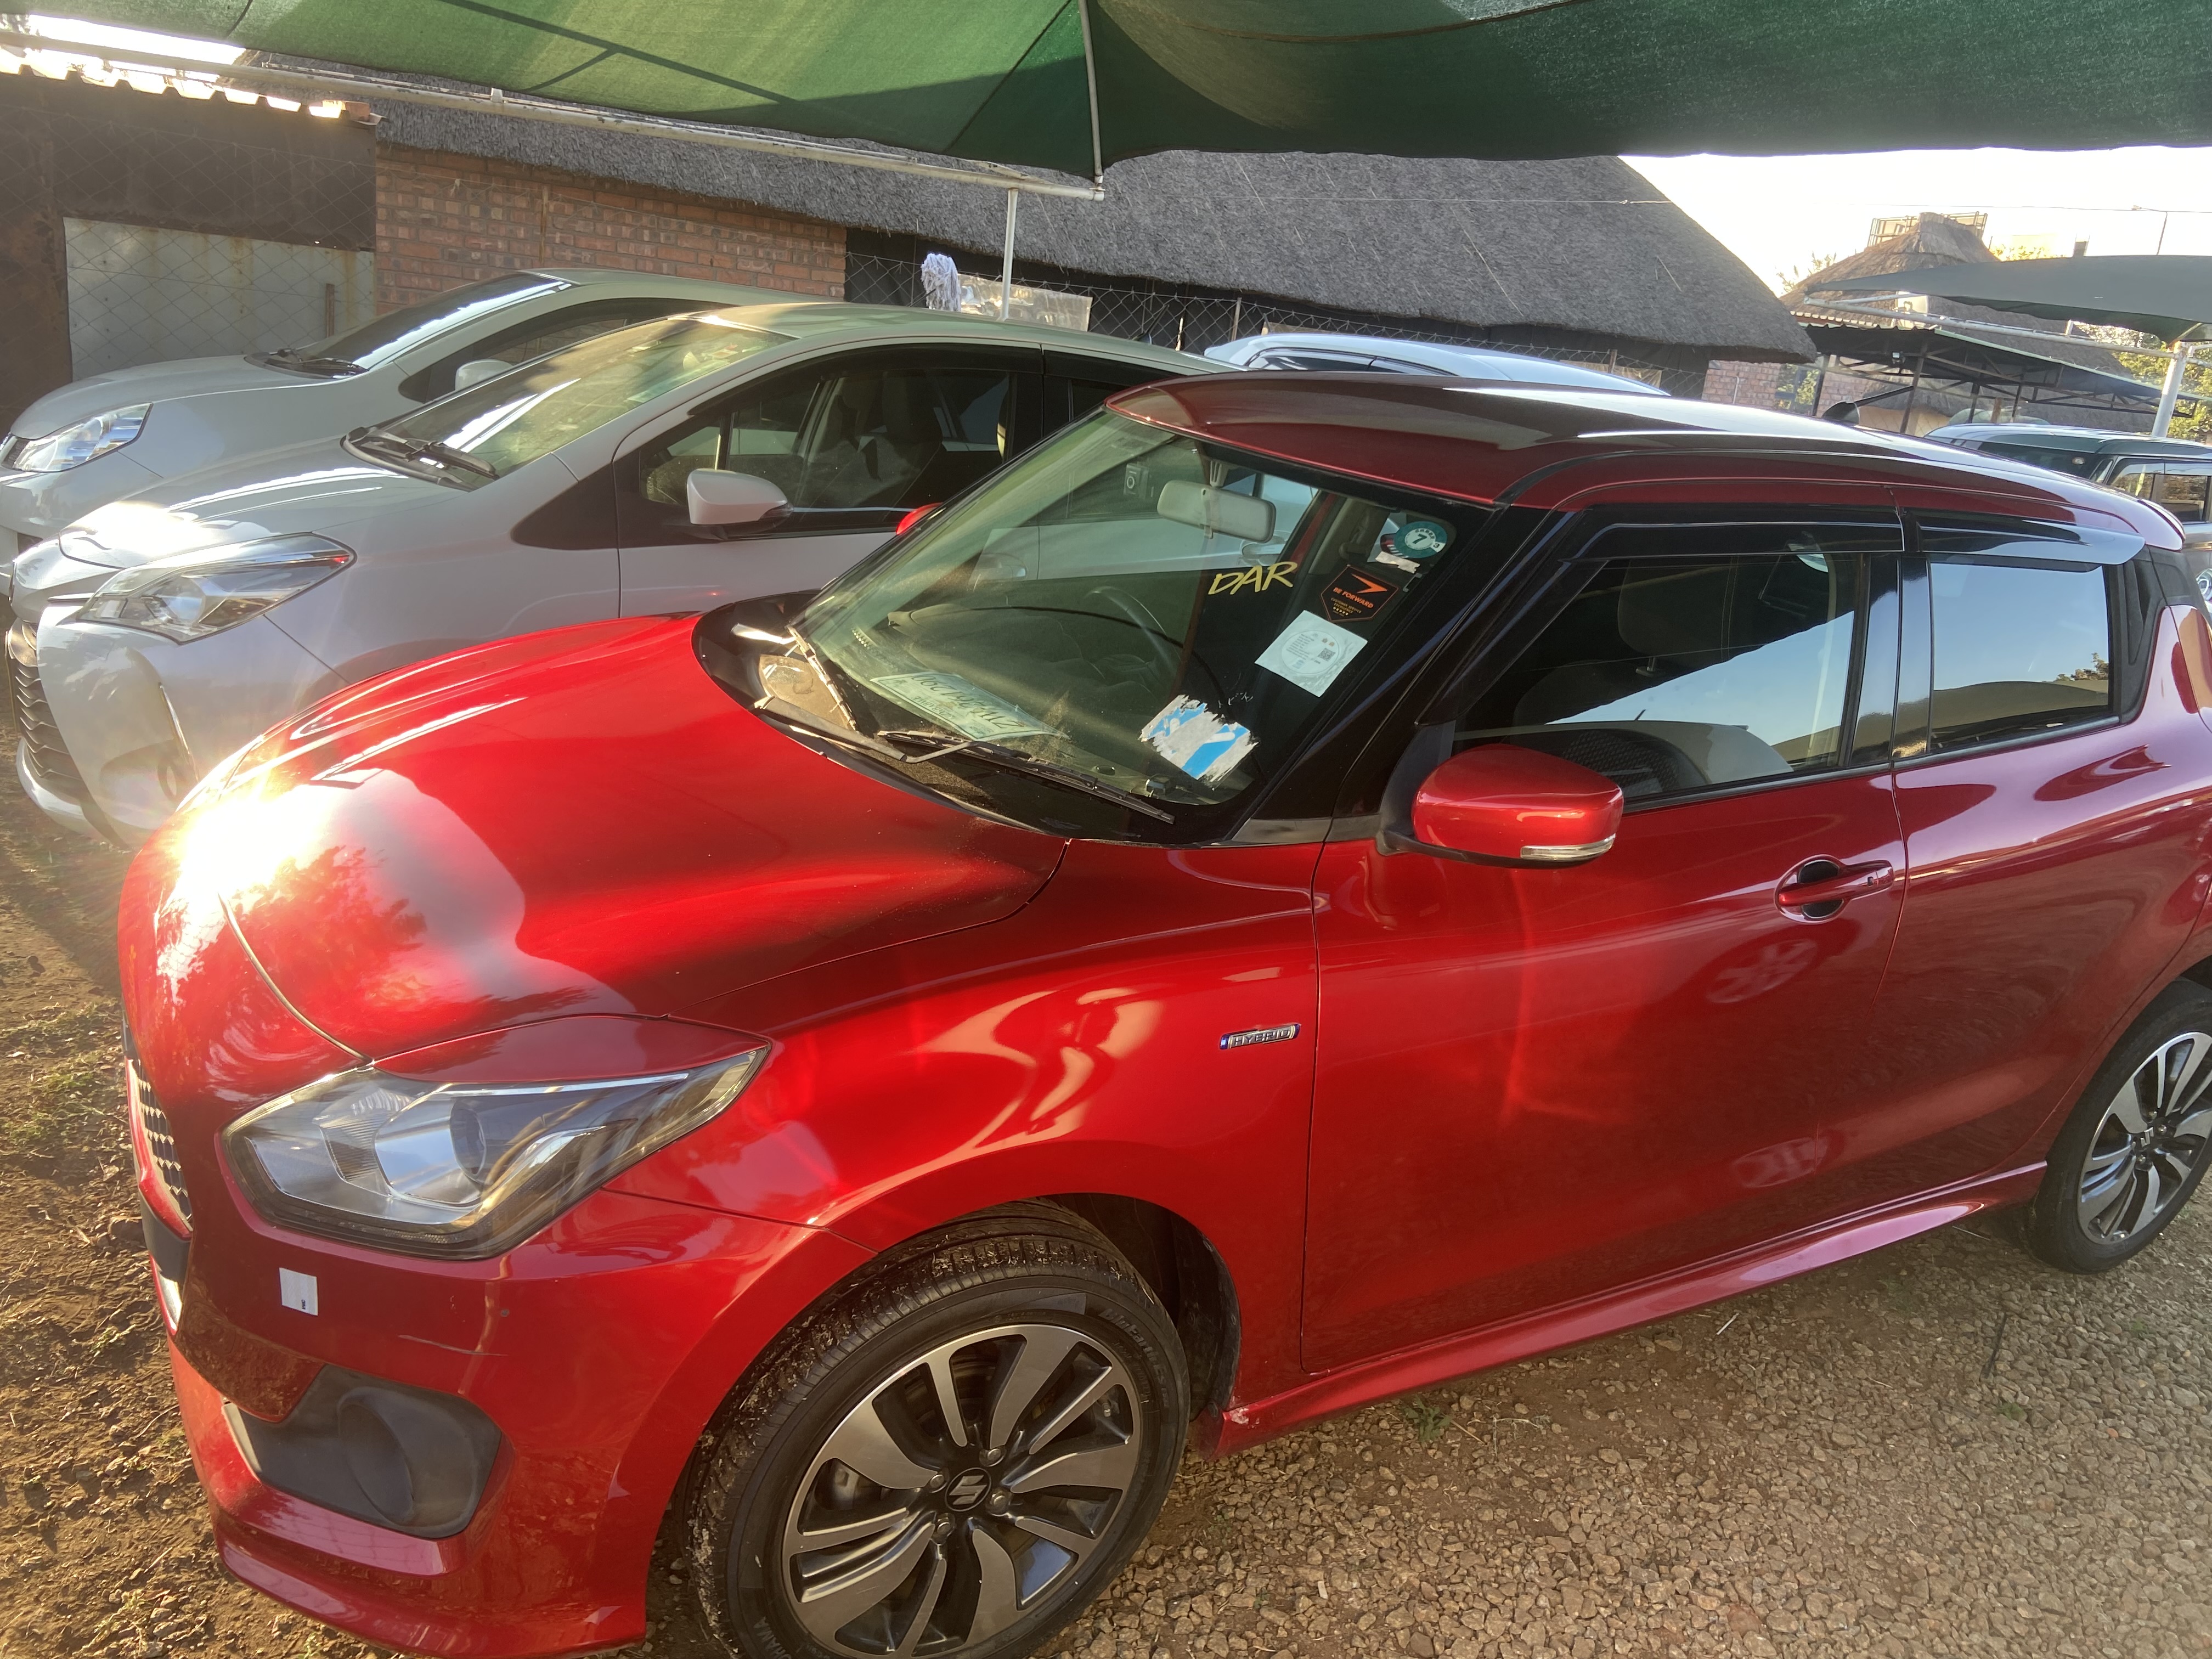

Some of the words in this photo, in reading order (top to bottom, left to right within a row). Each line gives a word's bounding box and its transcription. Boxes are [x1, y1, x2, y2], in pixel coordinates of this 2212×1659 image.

[1412, 533, 1427, 544] 7
[1208, 561, 1297, 595] DAR
[1341, 591, 1374, 608] FORWARD
[1235, 1029, 1290, 1046] HYBRID
